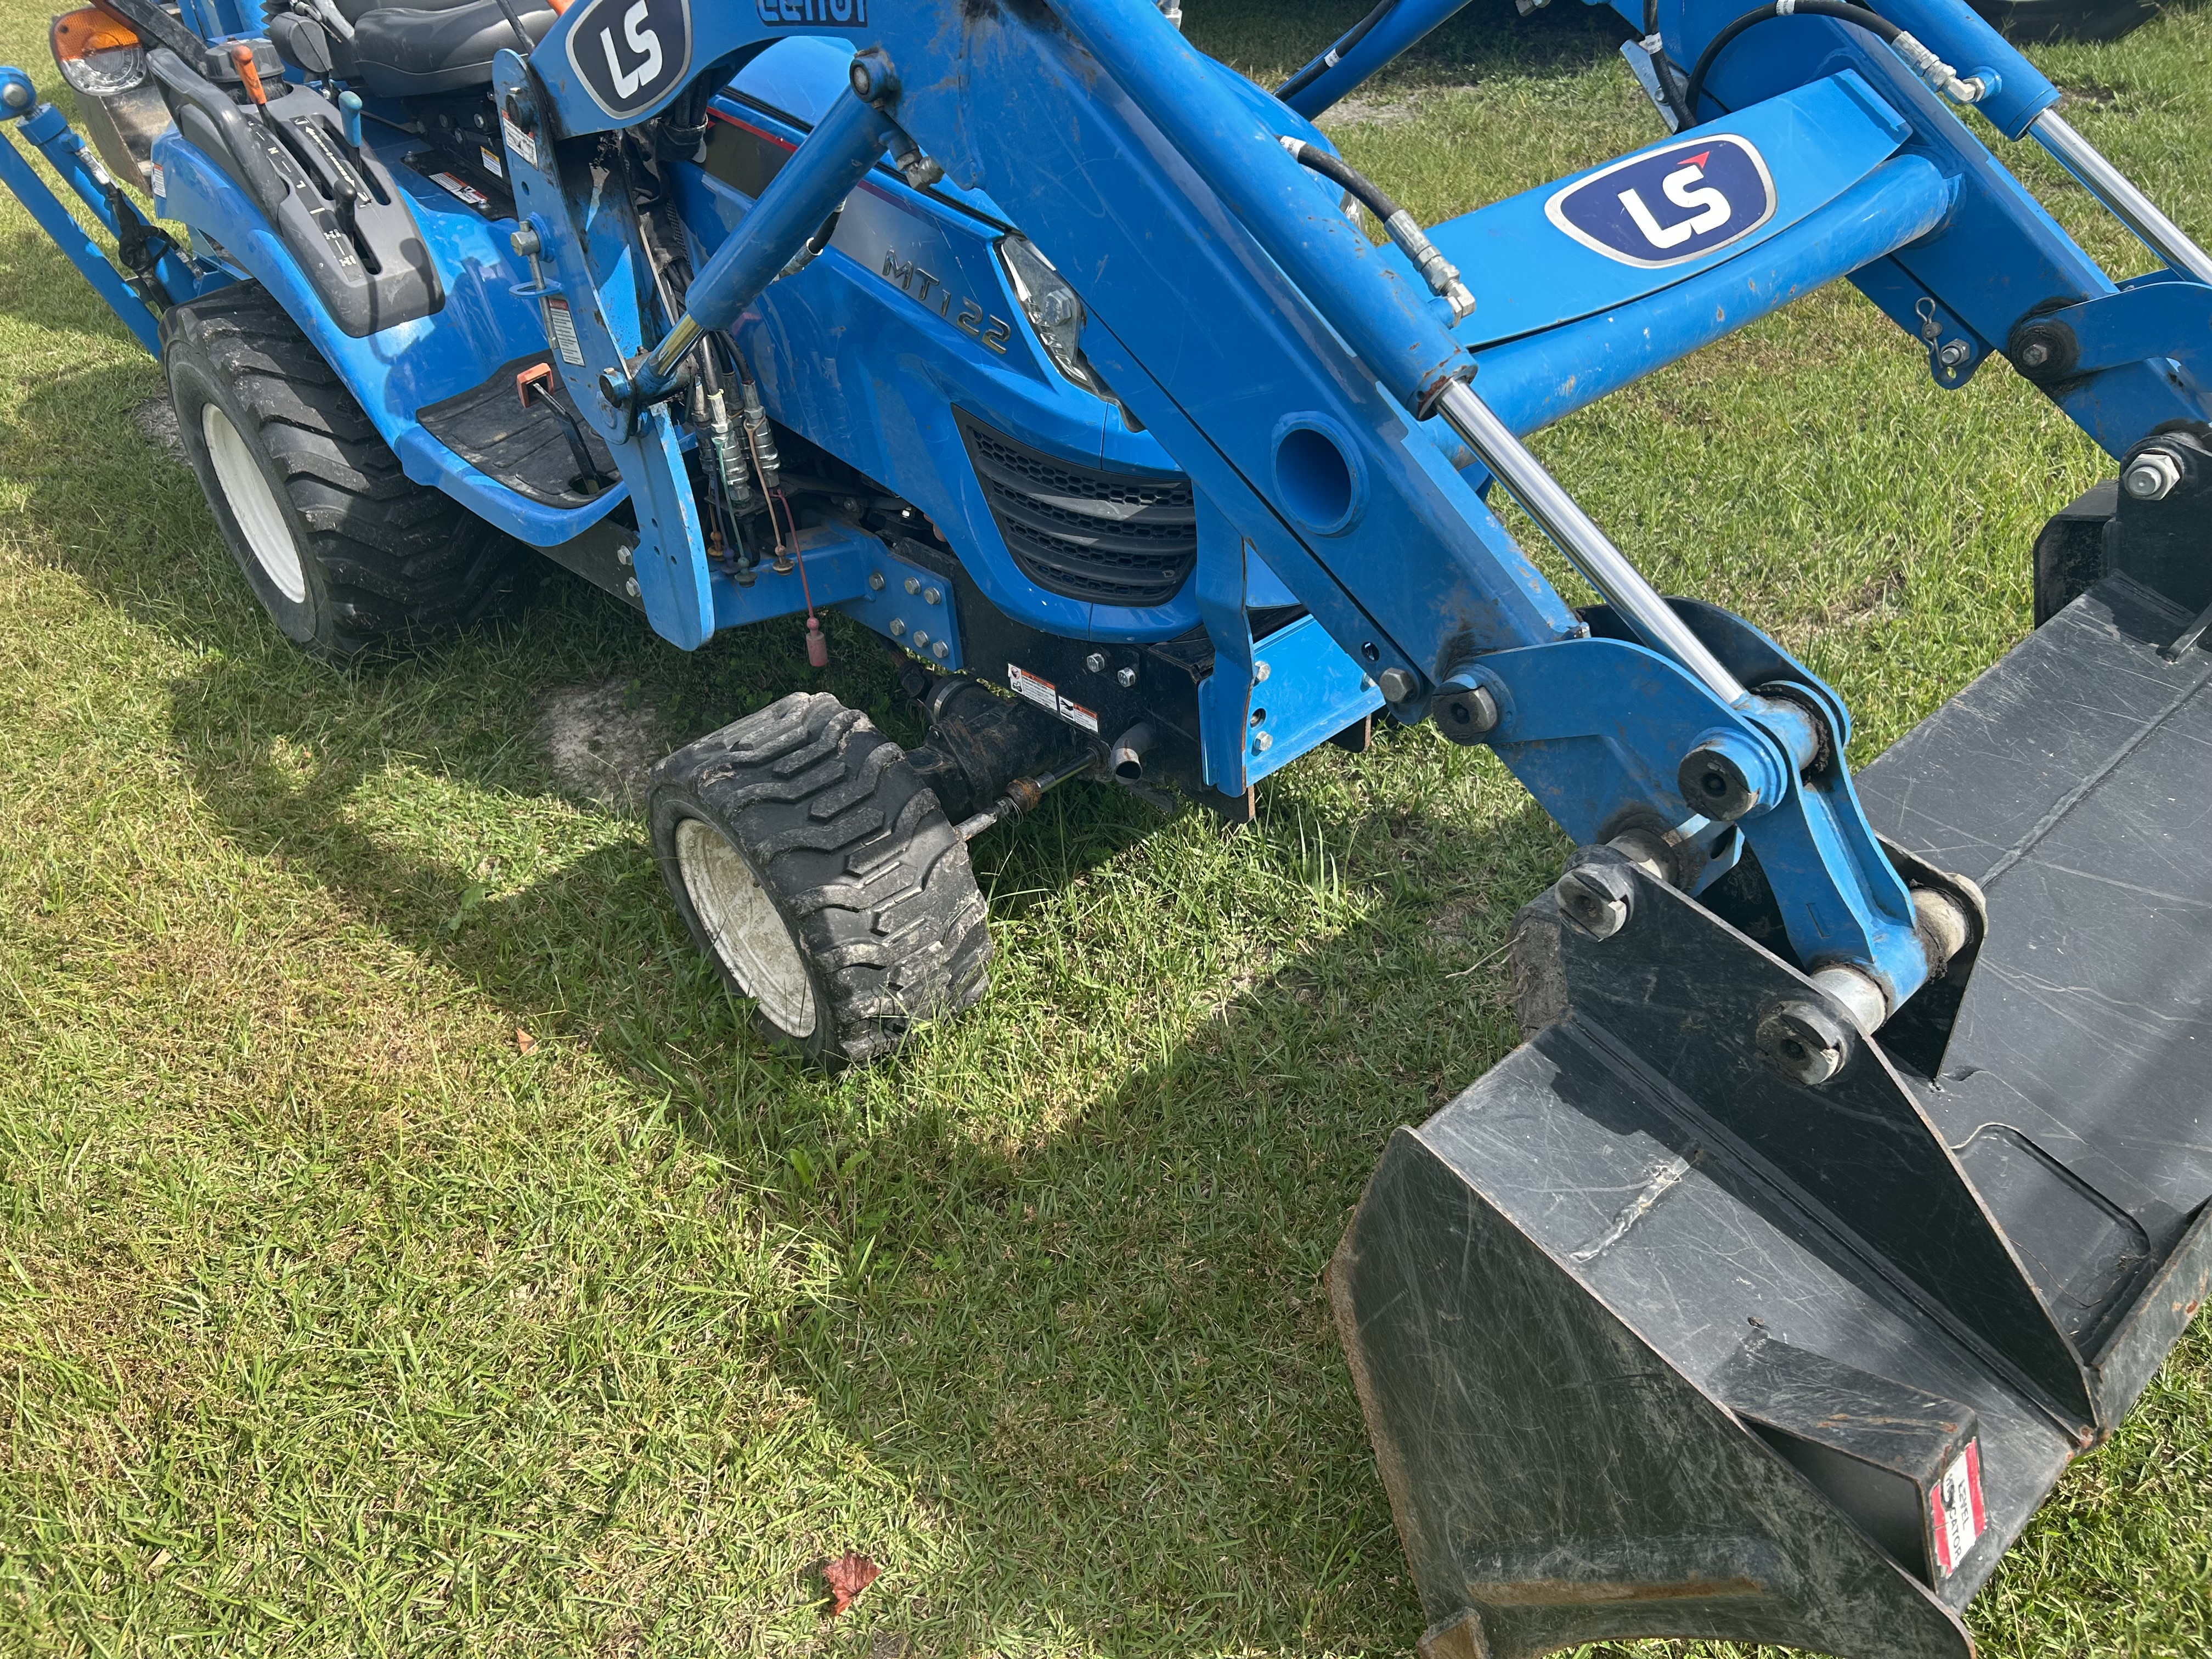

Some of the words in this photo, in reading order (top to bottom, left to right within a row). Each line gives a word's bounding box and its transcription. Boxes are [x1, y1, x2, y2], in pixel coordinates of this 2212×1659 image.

[600, 0, 663, 99] LS
[1617, 164, 1731, 249] LS
[882, 249, 1011, 354] MT122
